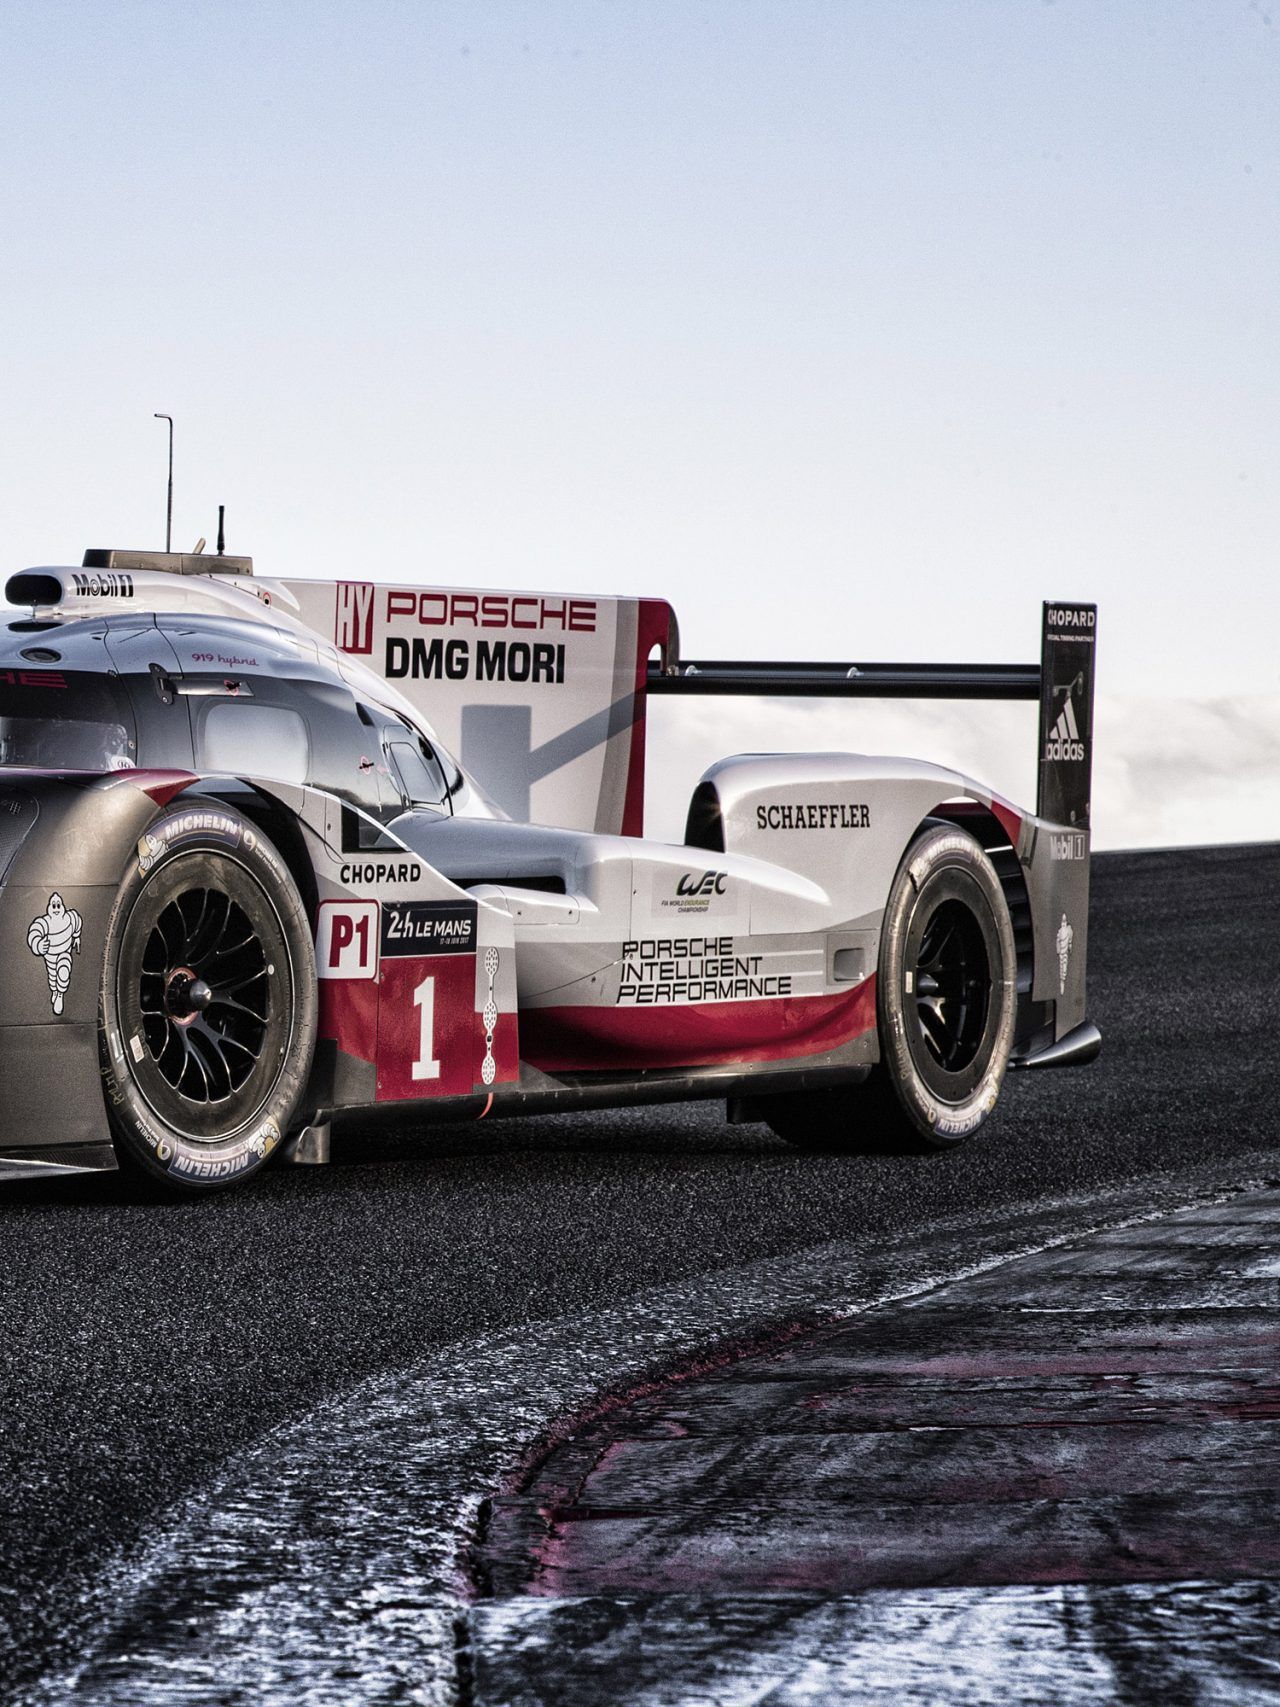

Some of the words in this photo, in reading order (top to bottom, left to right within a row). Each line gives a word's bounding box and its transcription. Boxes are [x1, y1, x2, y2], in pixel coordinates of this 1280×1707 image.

[71, 574, 118, 597] Mobil
[337, 584, 373, 649] HY
[386, 591, 597, 632] PORSCHE
[192, 653, 214, 662] 919
[217, 654, 260, 668] hybrid
[385, 637, 469, 680] DMG
[476, 640, 565, 684] MORI
[1045, 739, 1084, 760] adidas
[165, 814, 239, 840] MICHELIN
[756, 805, 870, 829] SCHAEFFLER
[340, 864, 421, 884] CHOPARD
[676, 870, 728, 897] WEC
[387, 911, 414, 939] 24h
[415, 921, 433, 938] LE
[433, 919, 471, 937] MANS
[329, 915, 369, 968] P1
[622, 937, 733, 960] PORSCHE
[621, 957, 762, 982] INTELLIGENT
[616, 976, 791, 1004] PERFORMANCE
[411, 976, 441, 1081] 1
[174, 1150, 249, 1177] MICHELIN
